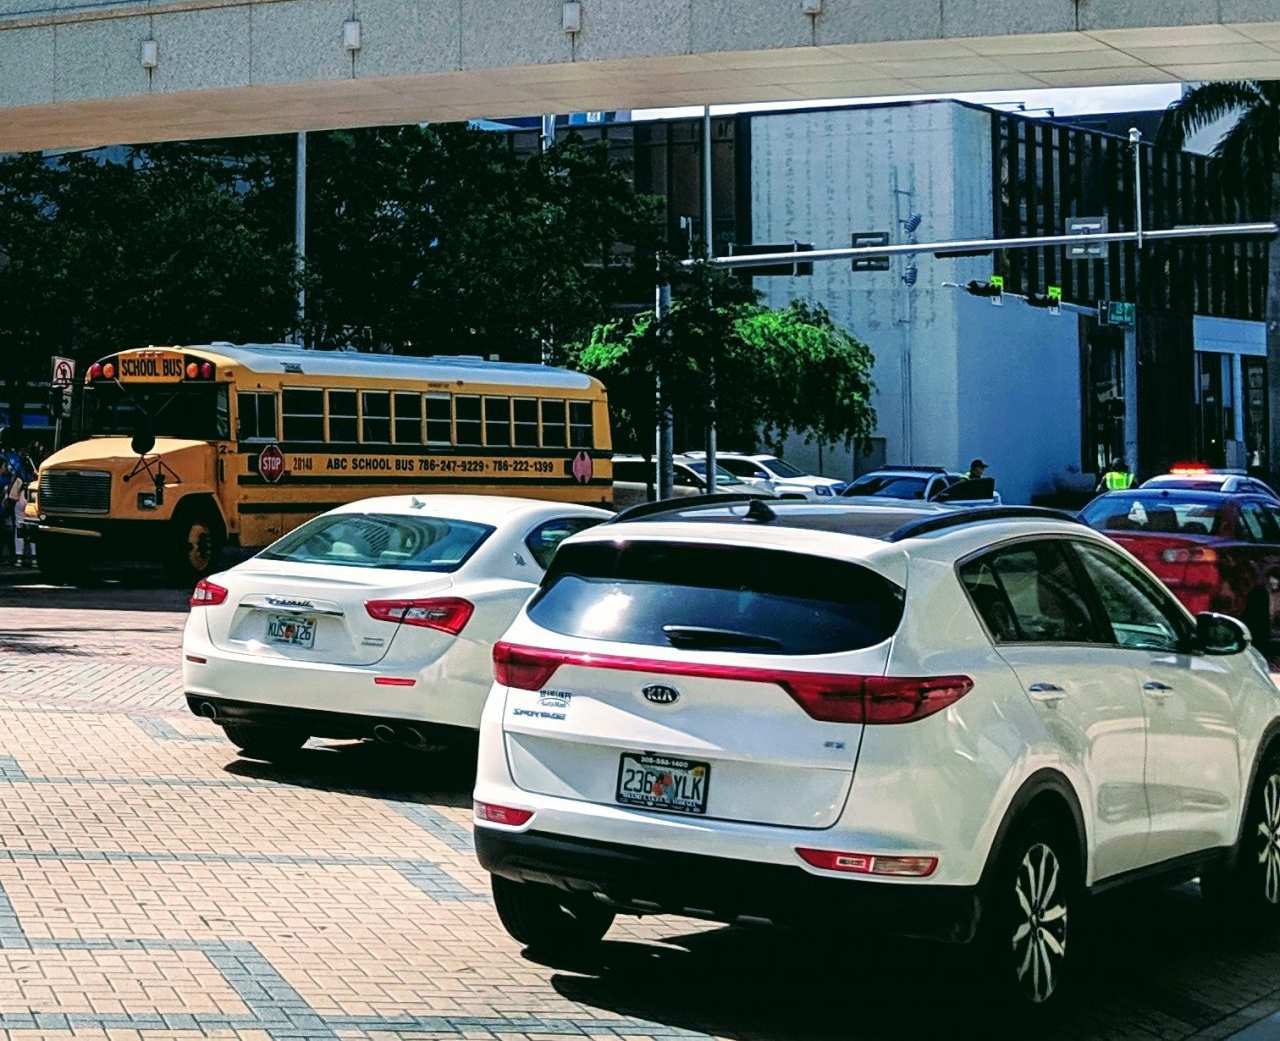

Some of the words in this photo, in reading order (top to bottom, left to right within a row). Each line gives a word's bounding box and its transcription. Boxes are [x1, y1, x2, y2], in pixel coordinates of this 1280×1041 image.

[121, 359, 159, 377] SCHOOL
[163, 359, 183, 377] BUS
[262, 457, 281, 471] STOP
[326, 457, 347, 470] ABC
[351, 458, 392, 471] SCHOOL
[395, 458, 414, 472] BUS
[646, 687, 673, 702] KIA
[623, 769, 653, 794] 236
[673, 774, 703, 801] YLK
